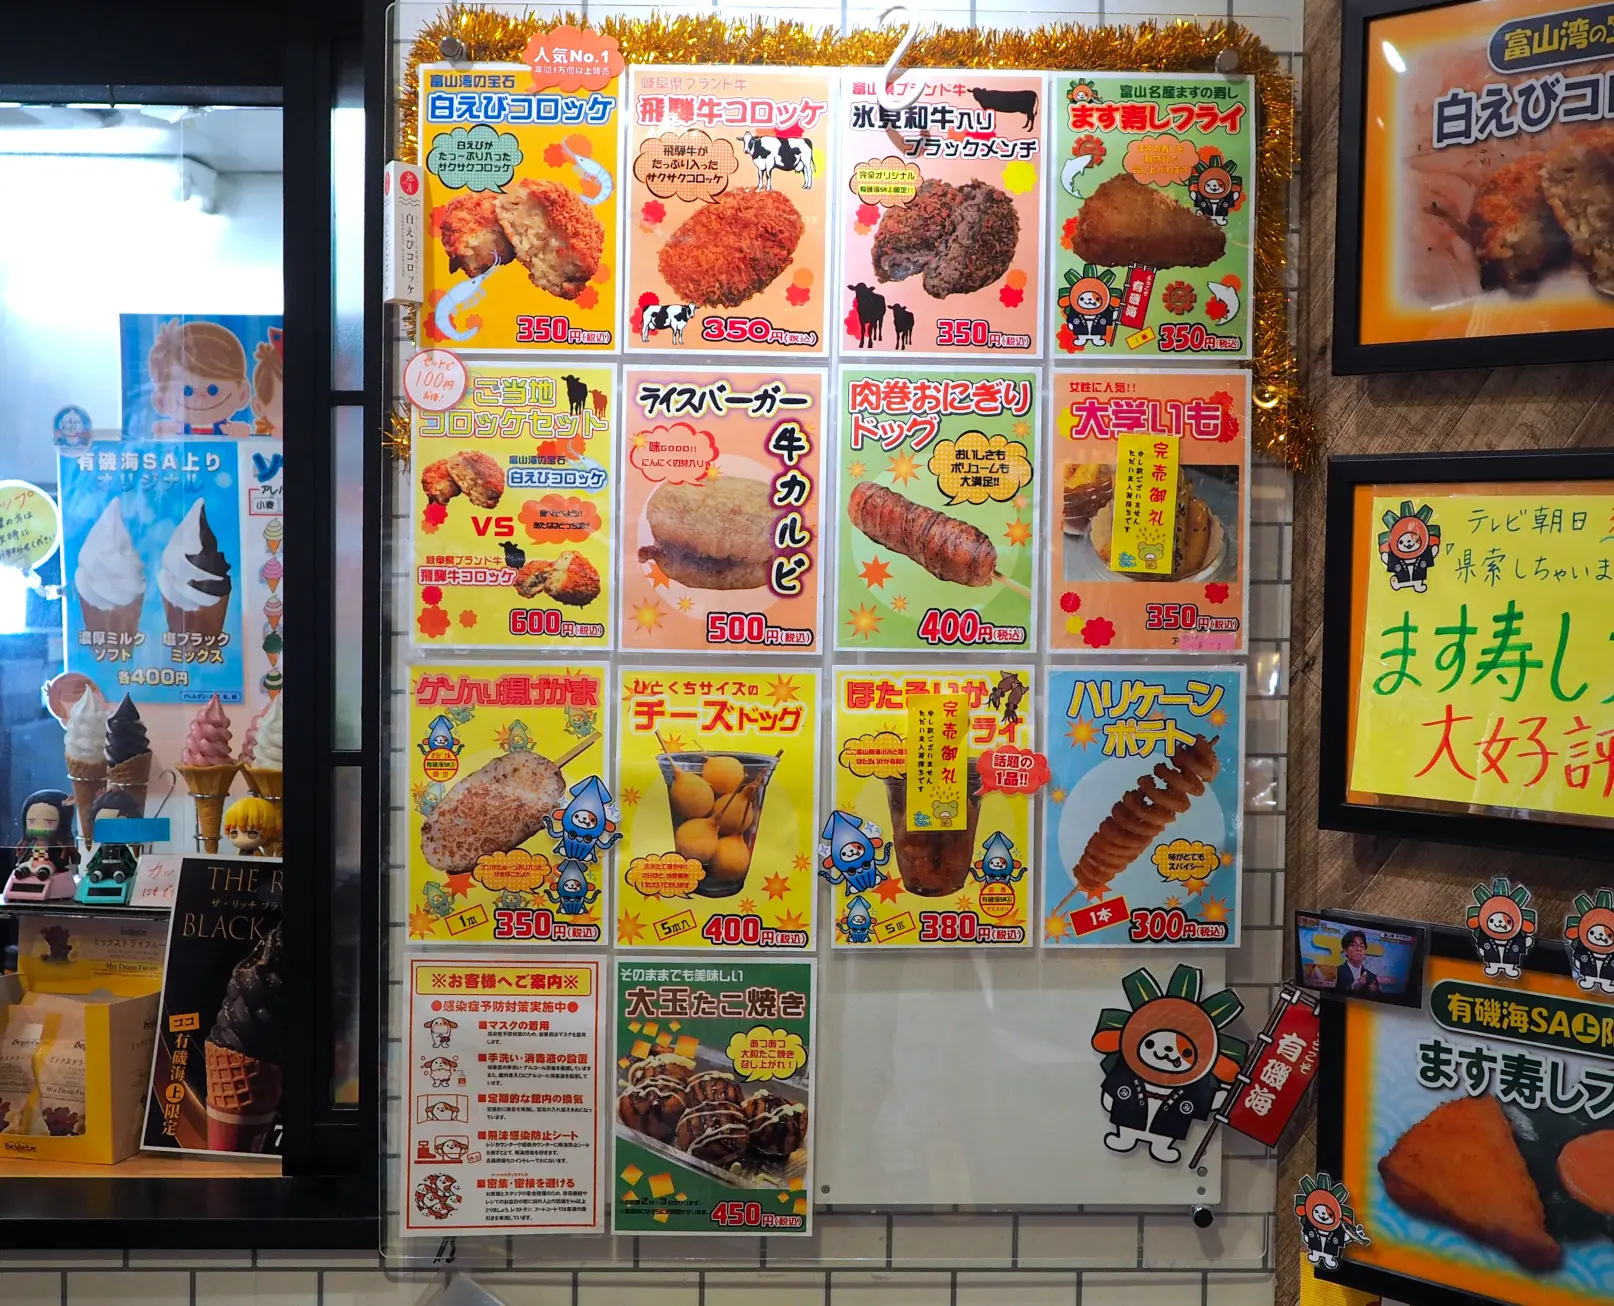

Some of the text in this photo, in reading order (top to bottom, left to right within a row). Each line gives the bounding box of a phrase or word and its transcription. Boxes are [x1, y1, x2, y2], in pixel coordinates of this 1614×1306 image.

[534, 47, 609, 64] 人気No.1
[534, 66, 610, 75] 年間1万個以上販売
[430, 75, 515, 88] 富山湾の宝石
[1120, 85, 1239, 99] 富山名産ますの寿し
[428, 93, 615, 123] 白えびコロッケ
[638, 95, 826, 128] 飛騨牛コロッケ
[852, 103, 994, 130] 氷見和牛入り
[1069, 102, 1246, 133] ます寿しフライ
[1435, 74, 1614, 144] 白えびコ
[457, 141, 493, 150] 白えびが
[663, 145, 708, 156] 飛騨牛が
[904, 138, 1038, 159] ブラックメンチ
[438, 163, 511, 172] サクサクコロッケ
[652, 159, 718, 170] たっぷり入った
[648, 174, 723, 184] サクサクコロッケ
[859, 171, 915, 180] 完全オリジナル
[406, 213, 415, 294] 白えびコロッケ
[516, 316, 612, 344] 350円(税込)
[702, 317, 818, 347] 350円(税込)
[937, 318, 1032, 347] 350円(税込)
[1158, 323, 1243, 352] 350円(税込)
[474, 377, 556, 407] ご当地
[850, 378, 1031, 415] 肉巻おにぎり
[1069, 382, 1137, 393] 女性に人気!!
[638, 383, 810, 415] ライスバーガー
[420, 408, 608, 438] コロッケセット
[1071, 398, 1222, 439] 大学いも
[852, 414, 940, 449] ドッグ
[77, 452, 221, 472] 有磯海SA上り
[641, 458, 704, 468] にんにくの芽入り
[955, 450, 1006, 460] おいしさも
[509, 469, 607, 487] 白えびコロッケ
[951, 463, 1009, 473] ボリュームも
[1124, 450, 1135, 532] ただいま入荷待ちです
[1133, 450, 1144, 525] 申し訳ございません
[1149, 442, 1168, 526] 完売御礼
[772, 426, 806, 591] 牛カルビ
[471, 516, 515, 537] VS
[1468, 507, 1588, 535] テレビ朝日
[418, 566, 517, 585] 飛騨牛コロッケ
[509, 609, 604, 637] 600円(税込)
[707, 613, 812, 646] 500円(税込)
[918, 608, 1026, 645] 400円(税込)
[78, 631, 146, 646] 濃厚ミルク
[163, 632, 230, 646] 塩ブラック
[95, 649, 132, 662] ソフト
[172, 649, 223, 663] ミックス
[117, 668, 188, 686] 各400円
[634, 679, 759, 696] ひとくちサイズの
[1066, 680, 1225, 719] ハリケーン
[634, 699, 804, 733] チーズドッグ
[926, 710, 934, 784] 申し訳ございません
[941, 700, 958, 784] 完売御礼
[1101, 718, 1197, 758] ポテト
[918, 710, 926, 792] ただいま入荷待ちです
[992, 754, 1034, 769] 話題の
[1168, 853, 1205, 862] 味がとても
[1168, 862, 1204, 871] スパイシー
[208, 866, 260, 892] THE
[183, 913, 265, 940] BLACK
[458, 915, 478, 927] 1本
[494, 908, 600, 940] 350円(税込)
[660, 919, 691, 935] 5本入
[919, 911, 1025, 943] 380円(税込)
[1089, 909, 1113, 926] 1本
[1128, 908, 1228, 942] 300円(税込)
[702, 914, 808, 948] 400円(税込)
[620, 969, 744, 982] そのままでも美味しい
[443, 1000, 566, 1013] 感染症予防対策実施中
[625, 985, 806, 1019] 大玉たこ焼き
[173, 1017, 195, 1027] ココ
[489, 1021, 550, 1031] マスクの着用
[741, 1050, 795, 1058] 大粒たこ焼き
[750, 1040, 786, 1048] あつあつ
[488, 1053, 588, 1064] 手洗い・消毒液の設置
[488, 1094, 583, 1104] 定期的な館内の換気
[488, 1131, 578, 1141] 飛沫感染防止シート
[487, 1178, 575, 1188] 密集・密接を避ける
